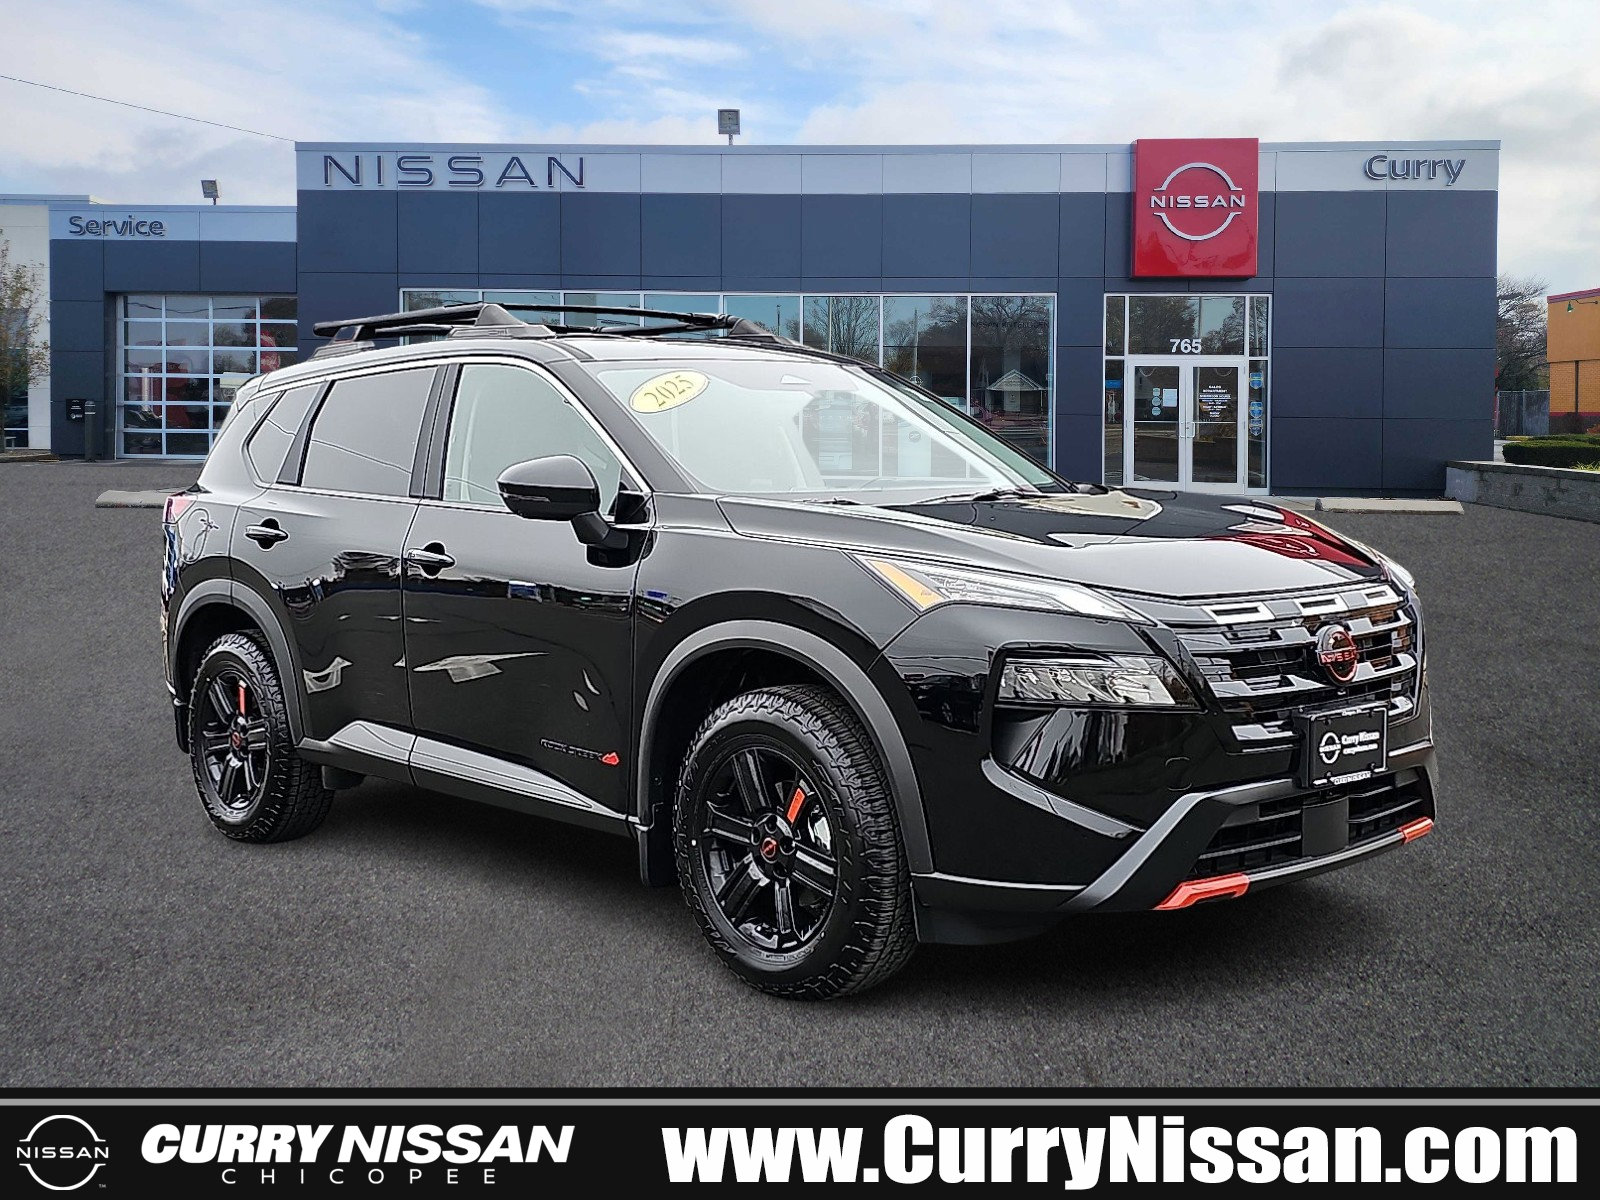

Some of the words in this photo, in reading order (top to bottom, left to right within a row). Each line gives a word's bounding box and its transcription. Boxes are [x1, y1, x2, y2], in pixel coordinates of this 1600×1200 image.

[323, 155, 585, 188] NISSAN
[1364, 154, 1466, 186] Curry
[1150, 194, 1246, 208] NISSAN
[68, 214, 167, 237] Service
[1169, 338, 1202, 353] 765
[643, 374, 695, 407] 2025
